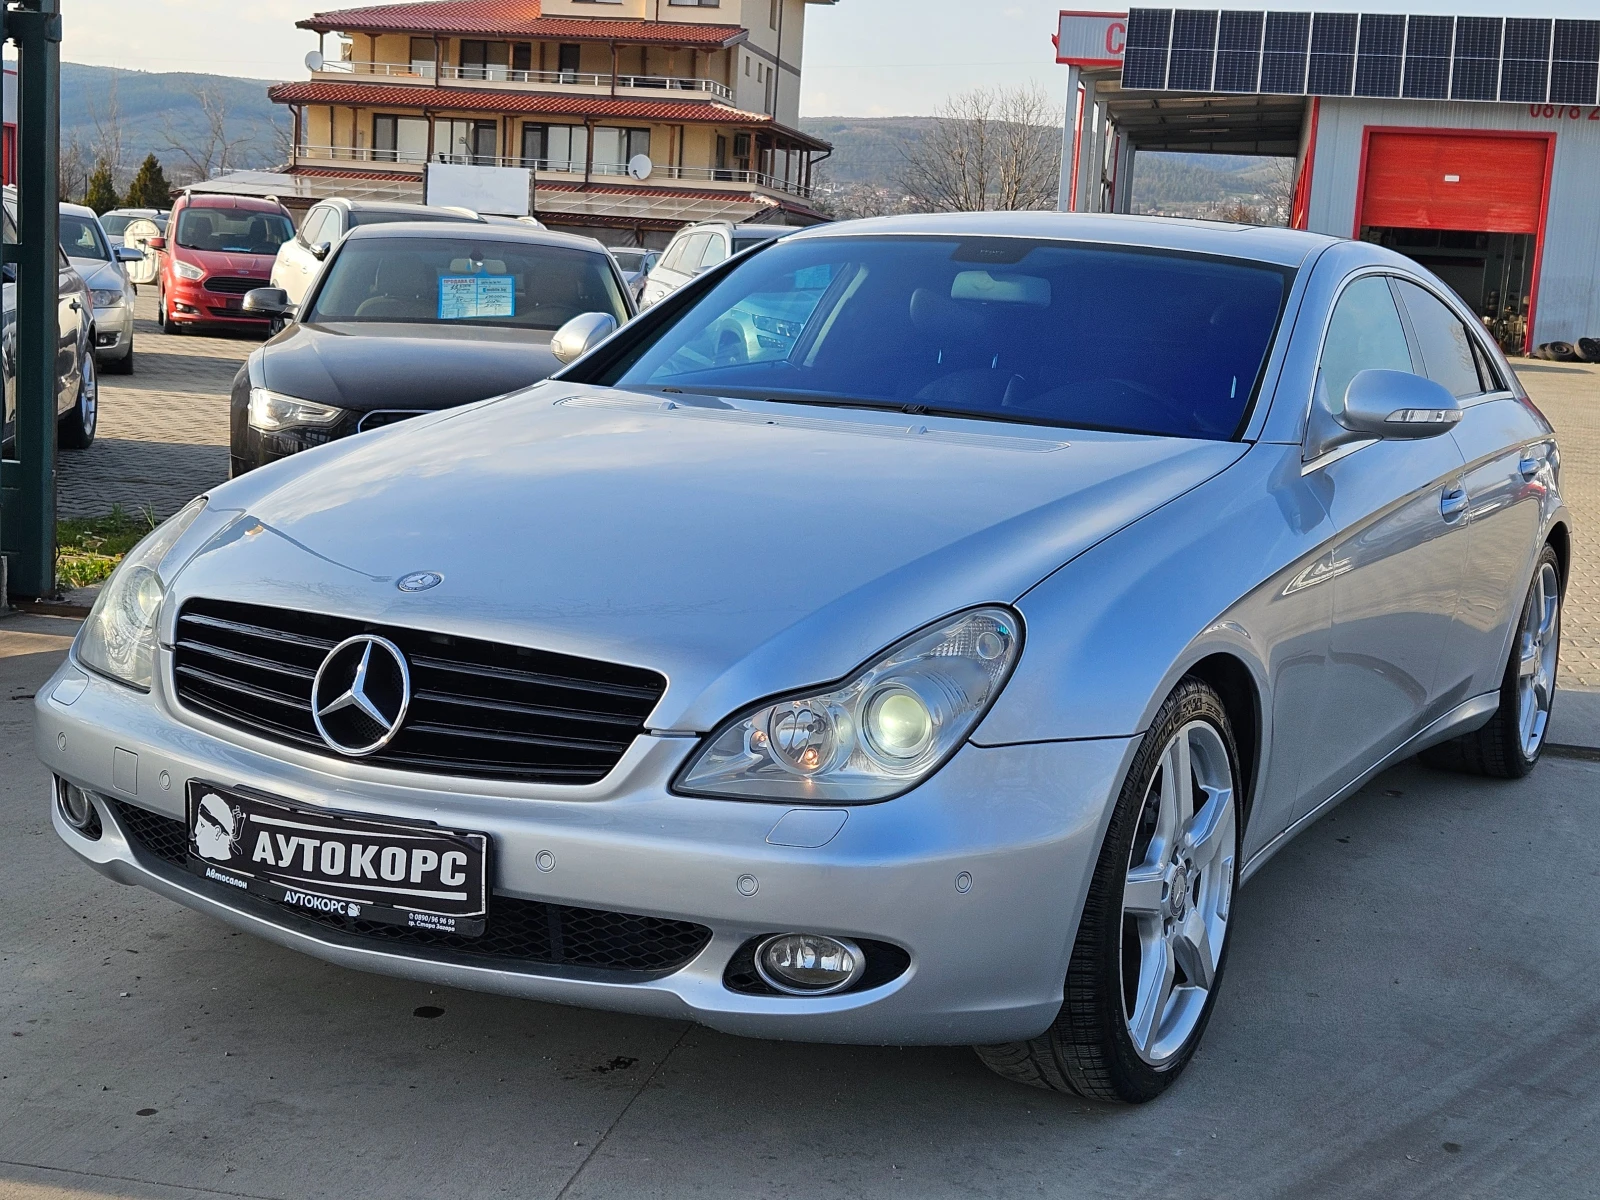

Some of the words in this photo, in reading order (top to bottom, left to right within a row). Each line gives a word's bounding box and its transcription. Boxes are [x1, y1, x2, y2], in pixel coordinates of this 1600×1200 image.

[252, 831, 467, 886] АУТОКОРС
[206, 867, 248, 889] Автосалон
[284, 890, 346, 914] АУТОКОРС
[436, 924, 455, 932] Загора
